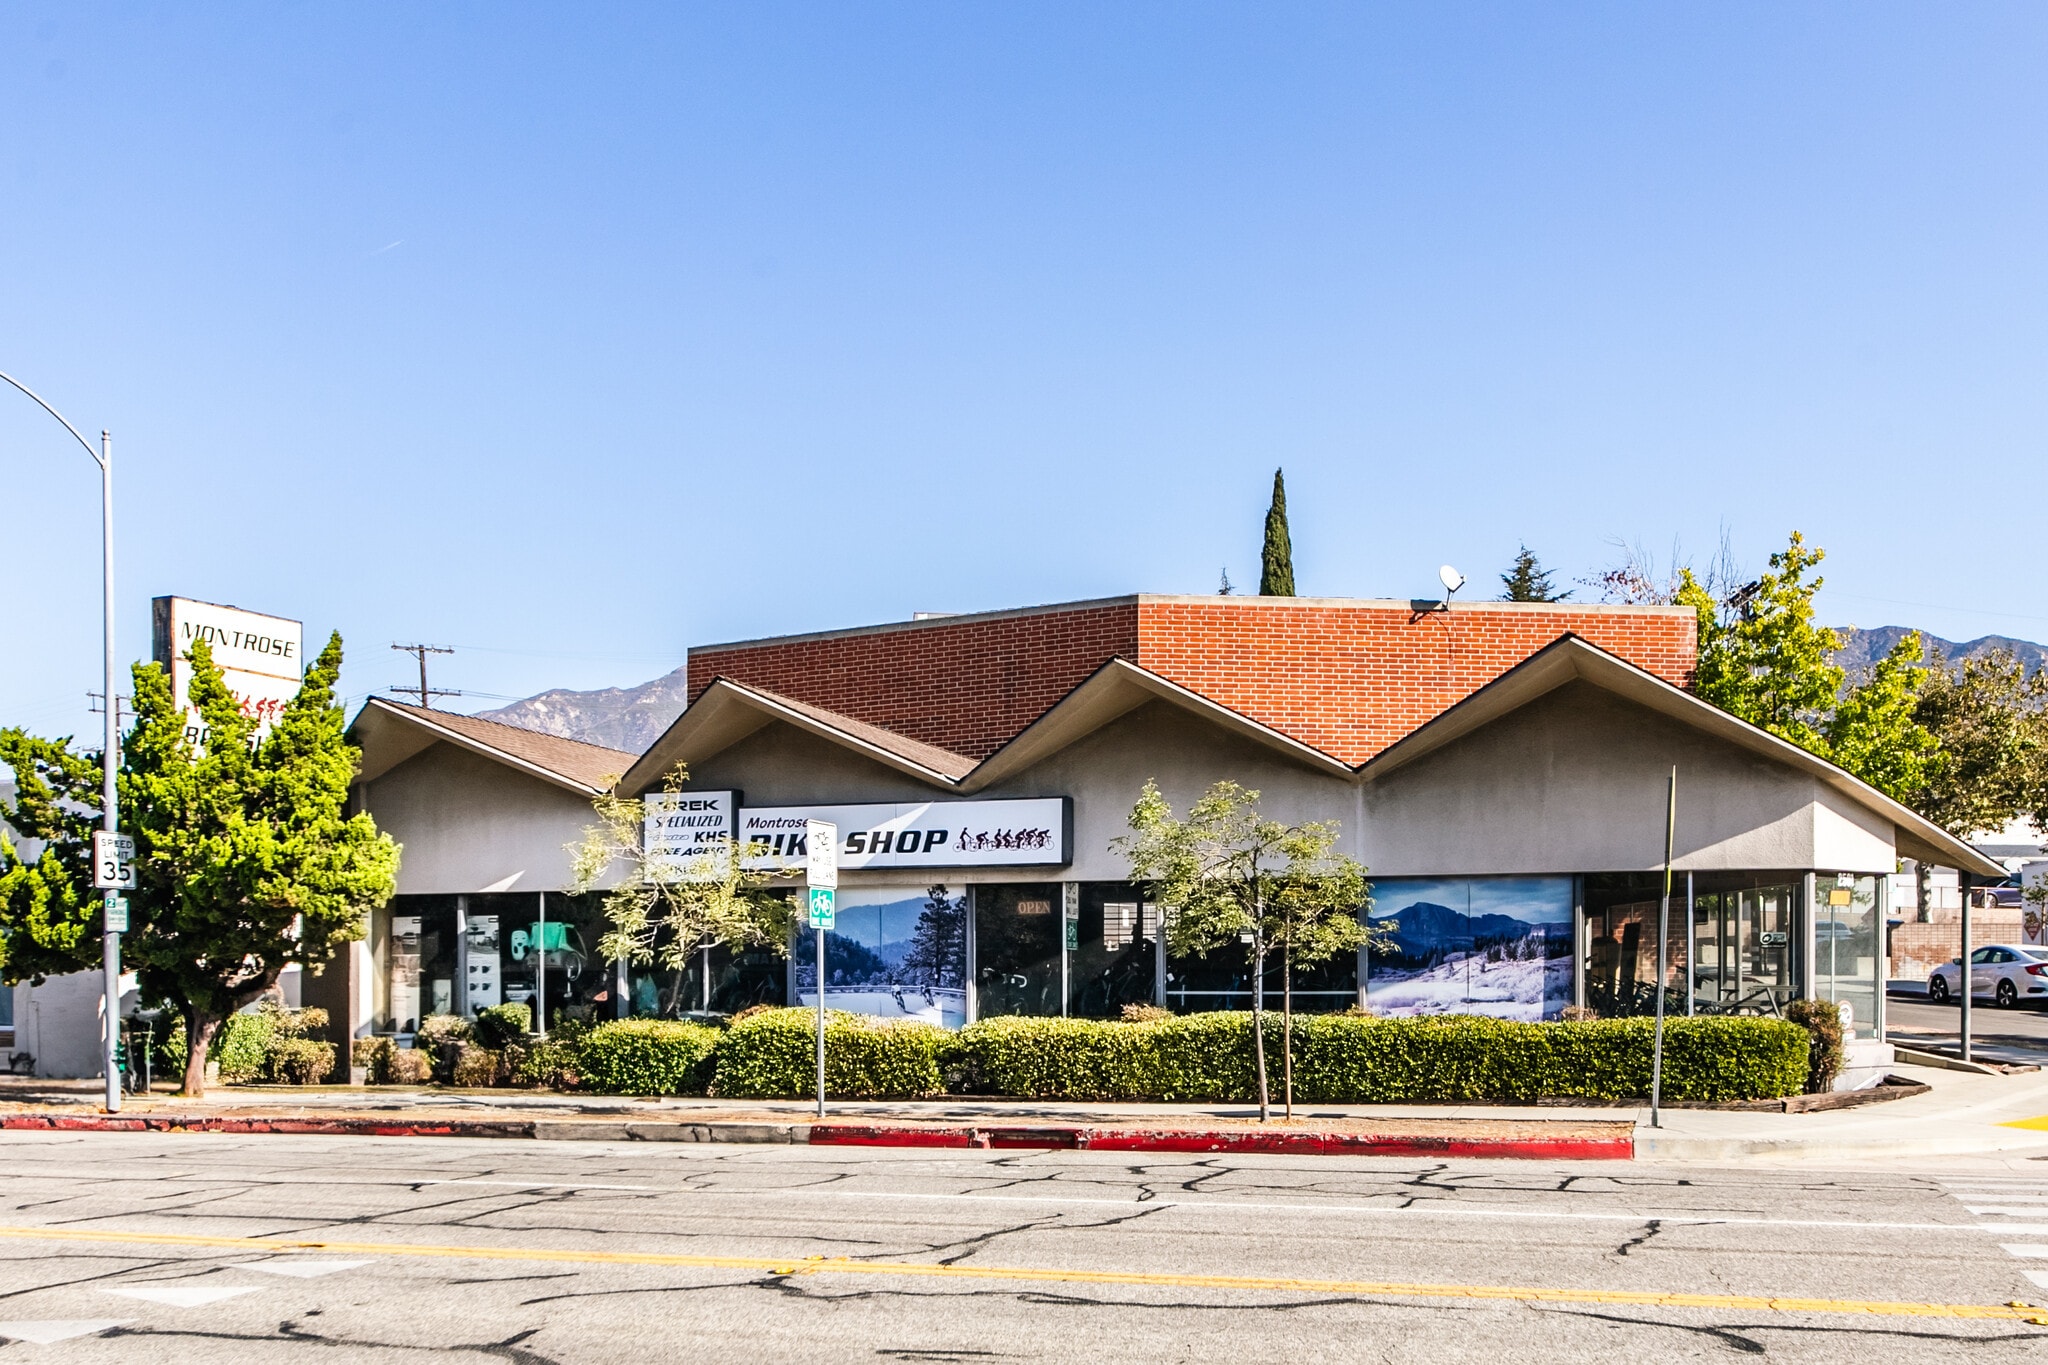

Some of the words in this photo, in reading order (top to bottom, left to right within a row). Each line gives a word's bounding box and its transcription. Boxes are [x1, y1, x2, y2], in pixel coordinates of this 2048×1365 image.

[181, 622, 295, 659] MONTROSE
[746, 816, 808, 829] Montrose
[694, 830, 728, 843] KHS
[748, 833, 808, 857] BIK
[844, 829, 949, 855] SHOP
[101, 838, 133, 849] SPEED
[104, 850, 129, 860] LIMIT
[103, 861, 131, 882] 35
[107, 898, 115, 907] 2
[1017, 901, 1051, 914] OPEN
